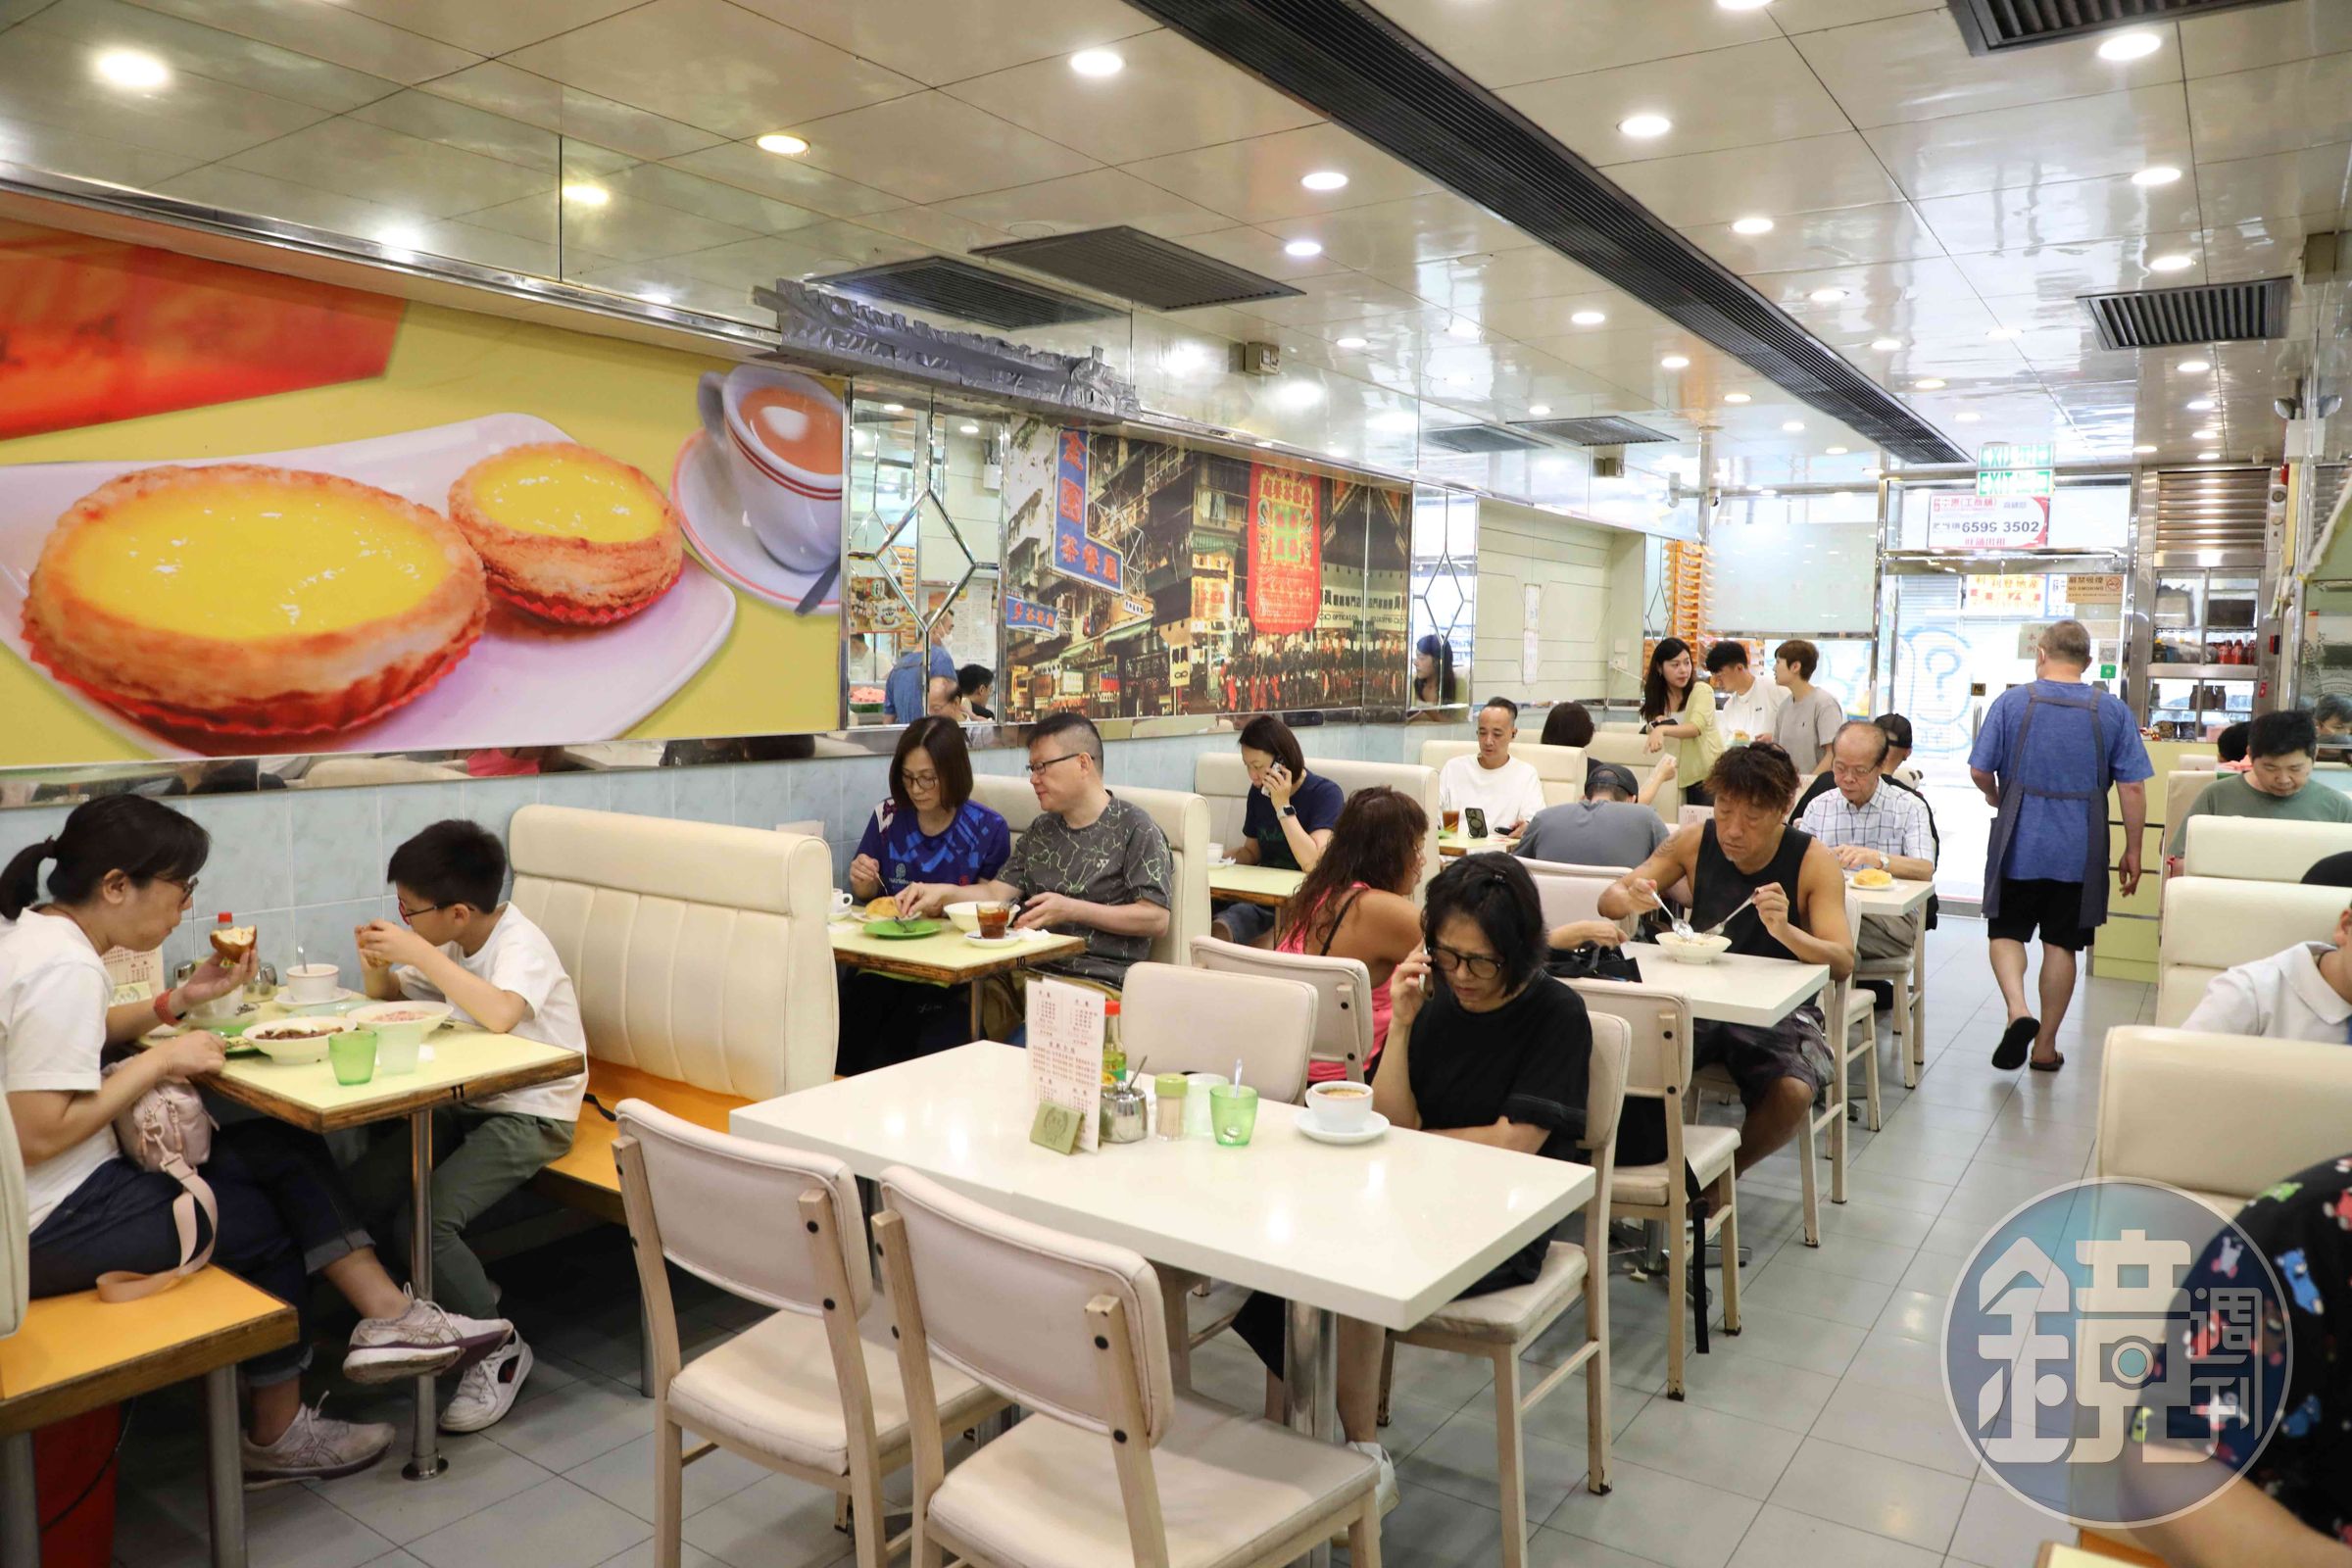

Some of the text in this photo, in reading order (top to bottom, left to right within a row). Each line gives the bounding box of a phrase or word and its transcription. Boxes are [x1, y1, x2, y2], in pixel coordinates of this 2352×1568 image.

[1980, 472, 2013, 494] EXIT
[2003, 521, 2039, 532] 3502
[1059, 533, 1119, 583] 茶餐廳
[1016, 956, 1026, 967] 10
